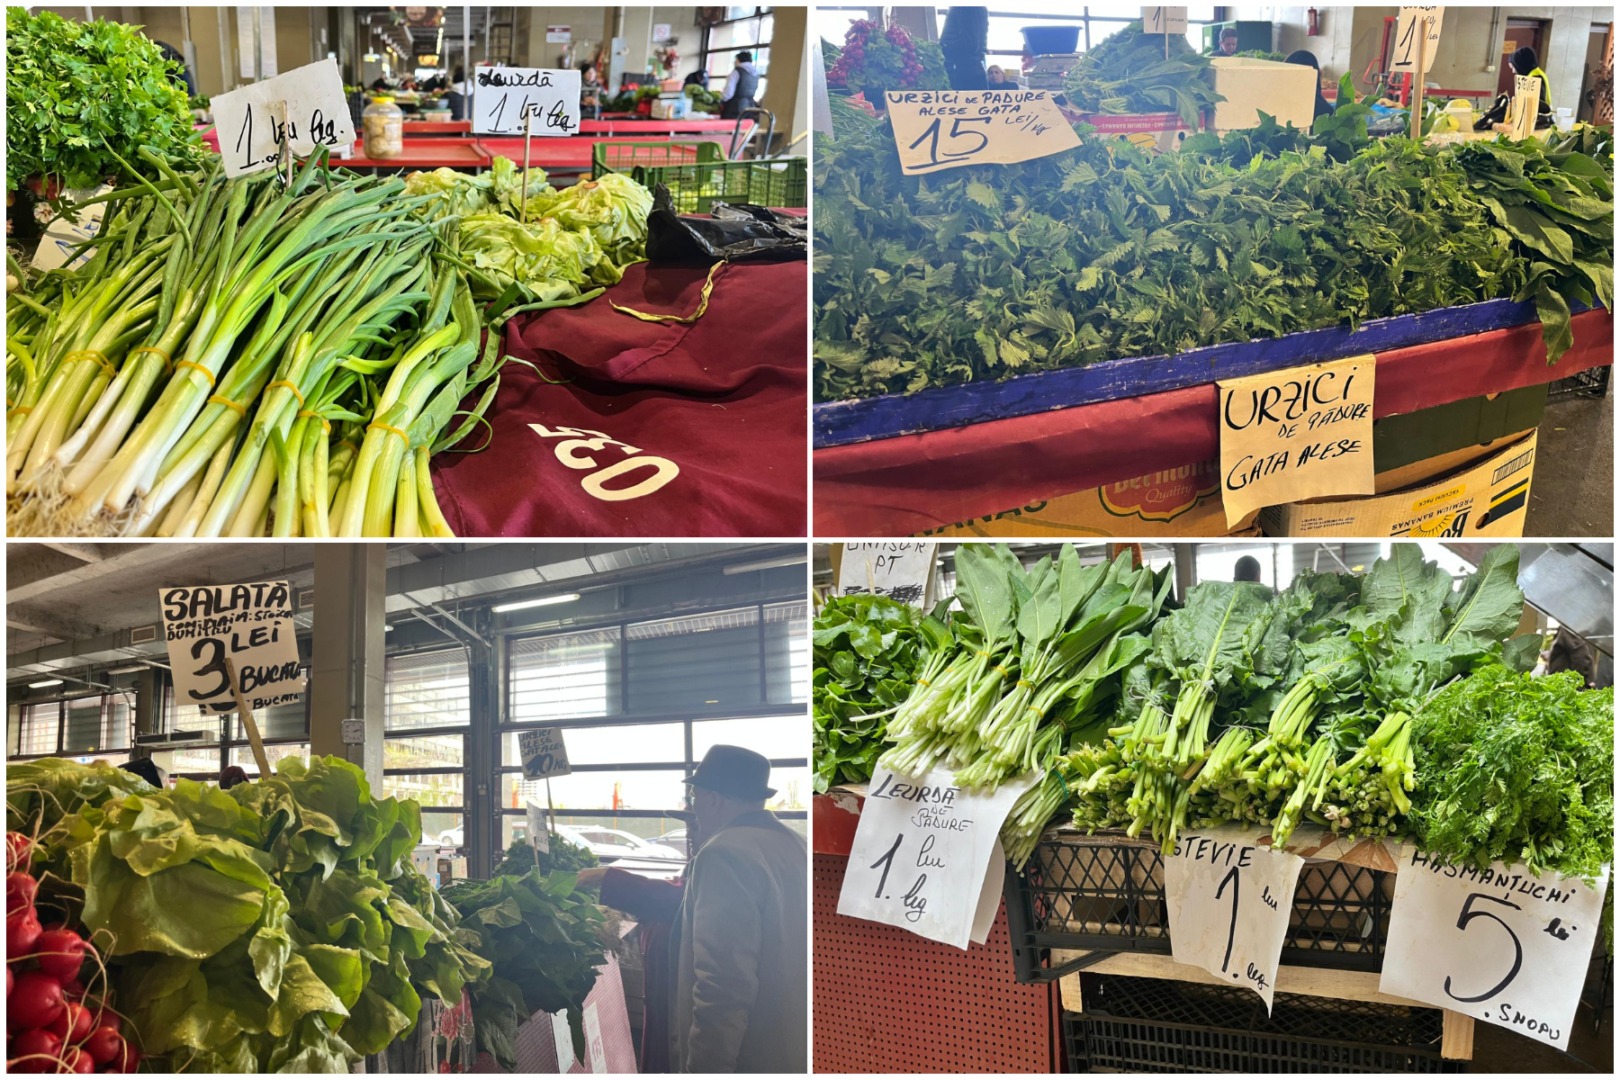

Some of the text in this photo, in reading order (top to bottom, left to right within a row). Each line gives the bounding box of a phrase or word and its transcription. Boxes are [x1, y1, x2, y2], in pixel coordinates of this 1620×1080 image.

[1394, 14, 1417, 66] 1
[919, 104, 1022, 116] ALESE GATA
[908, 116, 993, 164] 15
[1277, 423, 1300, 439] DE
[1226, 439, 1362, 491] GATA ALESE
[1391, 496, 1474, 531] PREMIUM BANANAS
[874, 554, 904, 575] PT
[231, 620, 281, 653] LEI
[1173, 835, 1256, 868] STEVIE
